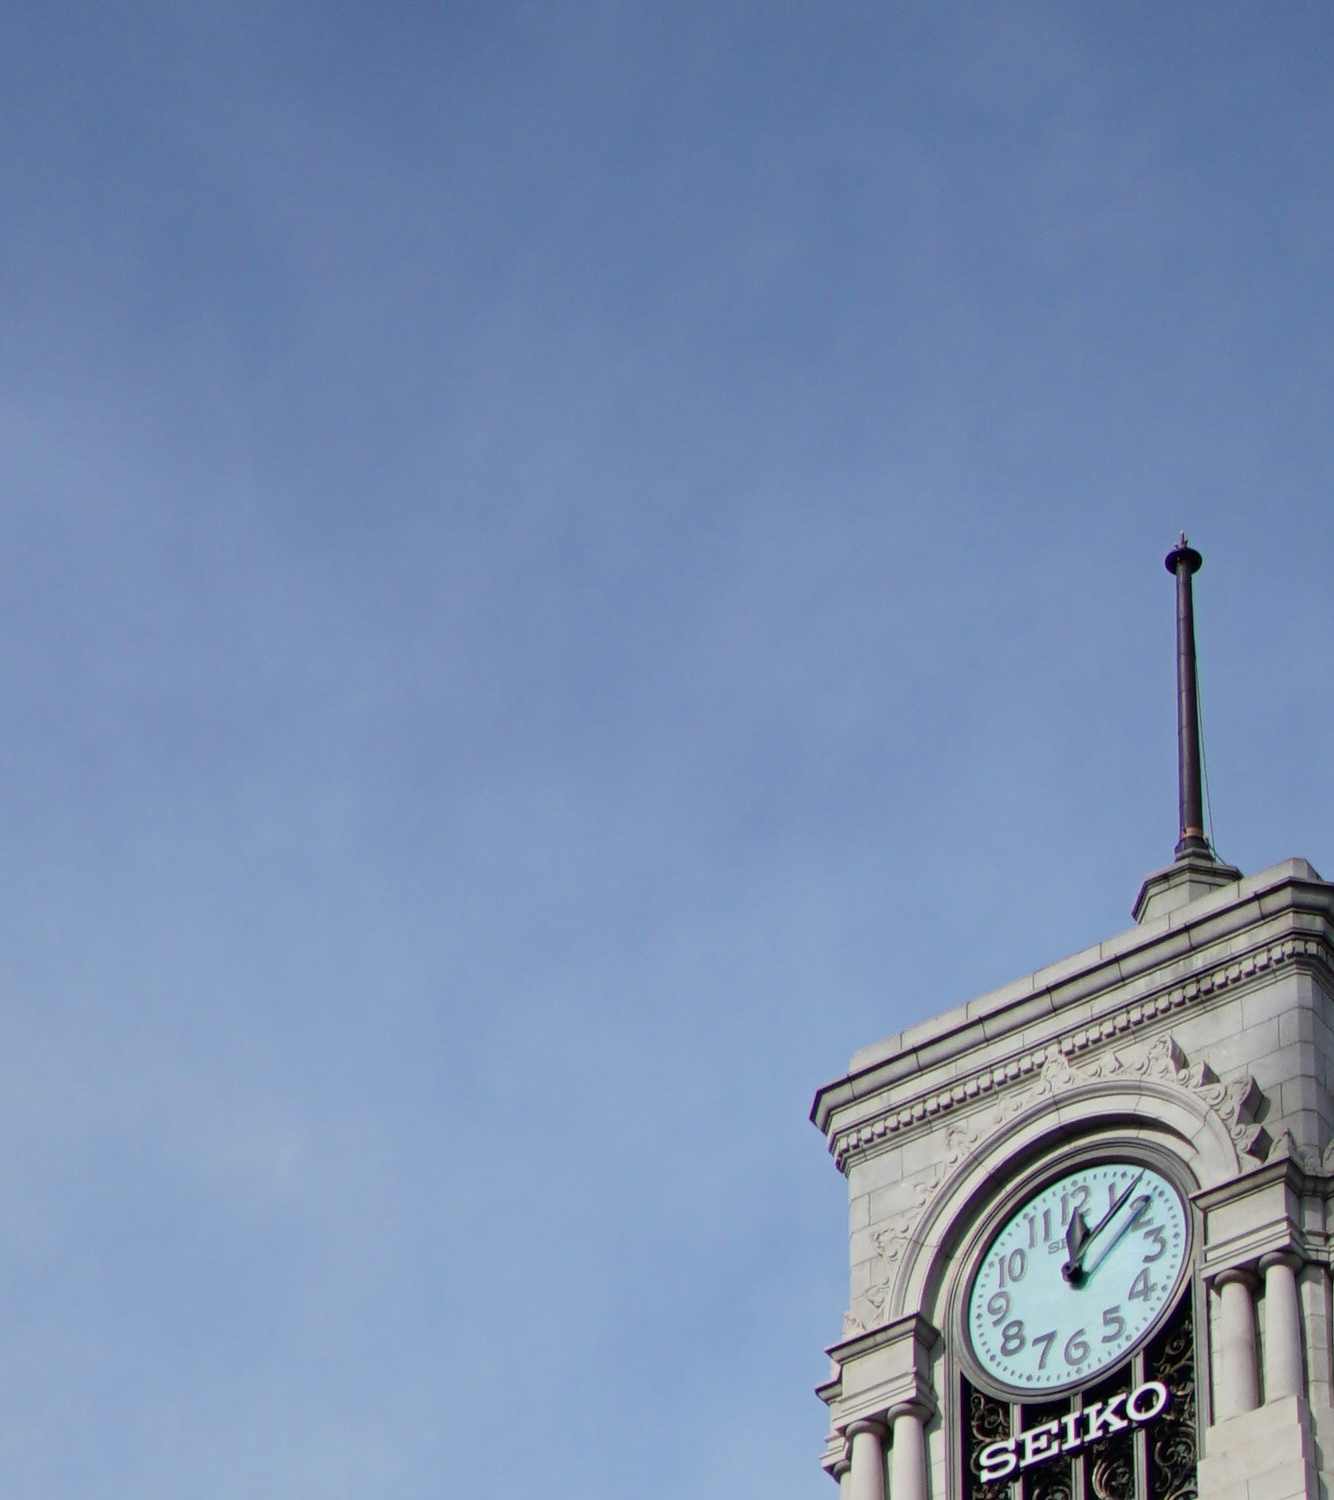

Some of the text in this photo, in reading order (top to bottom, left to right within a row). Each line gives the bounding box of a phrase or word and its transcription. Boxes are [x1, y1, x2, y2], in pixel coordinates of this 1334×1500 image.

[1028, 1208, 1053, 1249] 11
[1130, 1196, 1154, 1232] 2
[1142, 1225, 1167, 1263] 3
[998, 1248, 1027, 1289] 10
[1128, 1267, 1157, 1302] 4
[987, 1291, 1012, 1327] 9
[1101, 1305, 1126, 1343] 5
[1000, 1320, 1025, 1357] 8
[1032, 1330, 1057, 1370] 7
[1064, 1329, 1090, 1366] 6
[978, 1381, 1172, 1483] SEIKO
